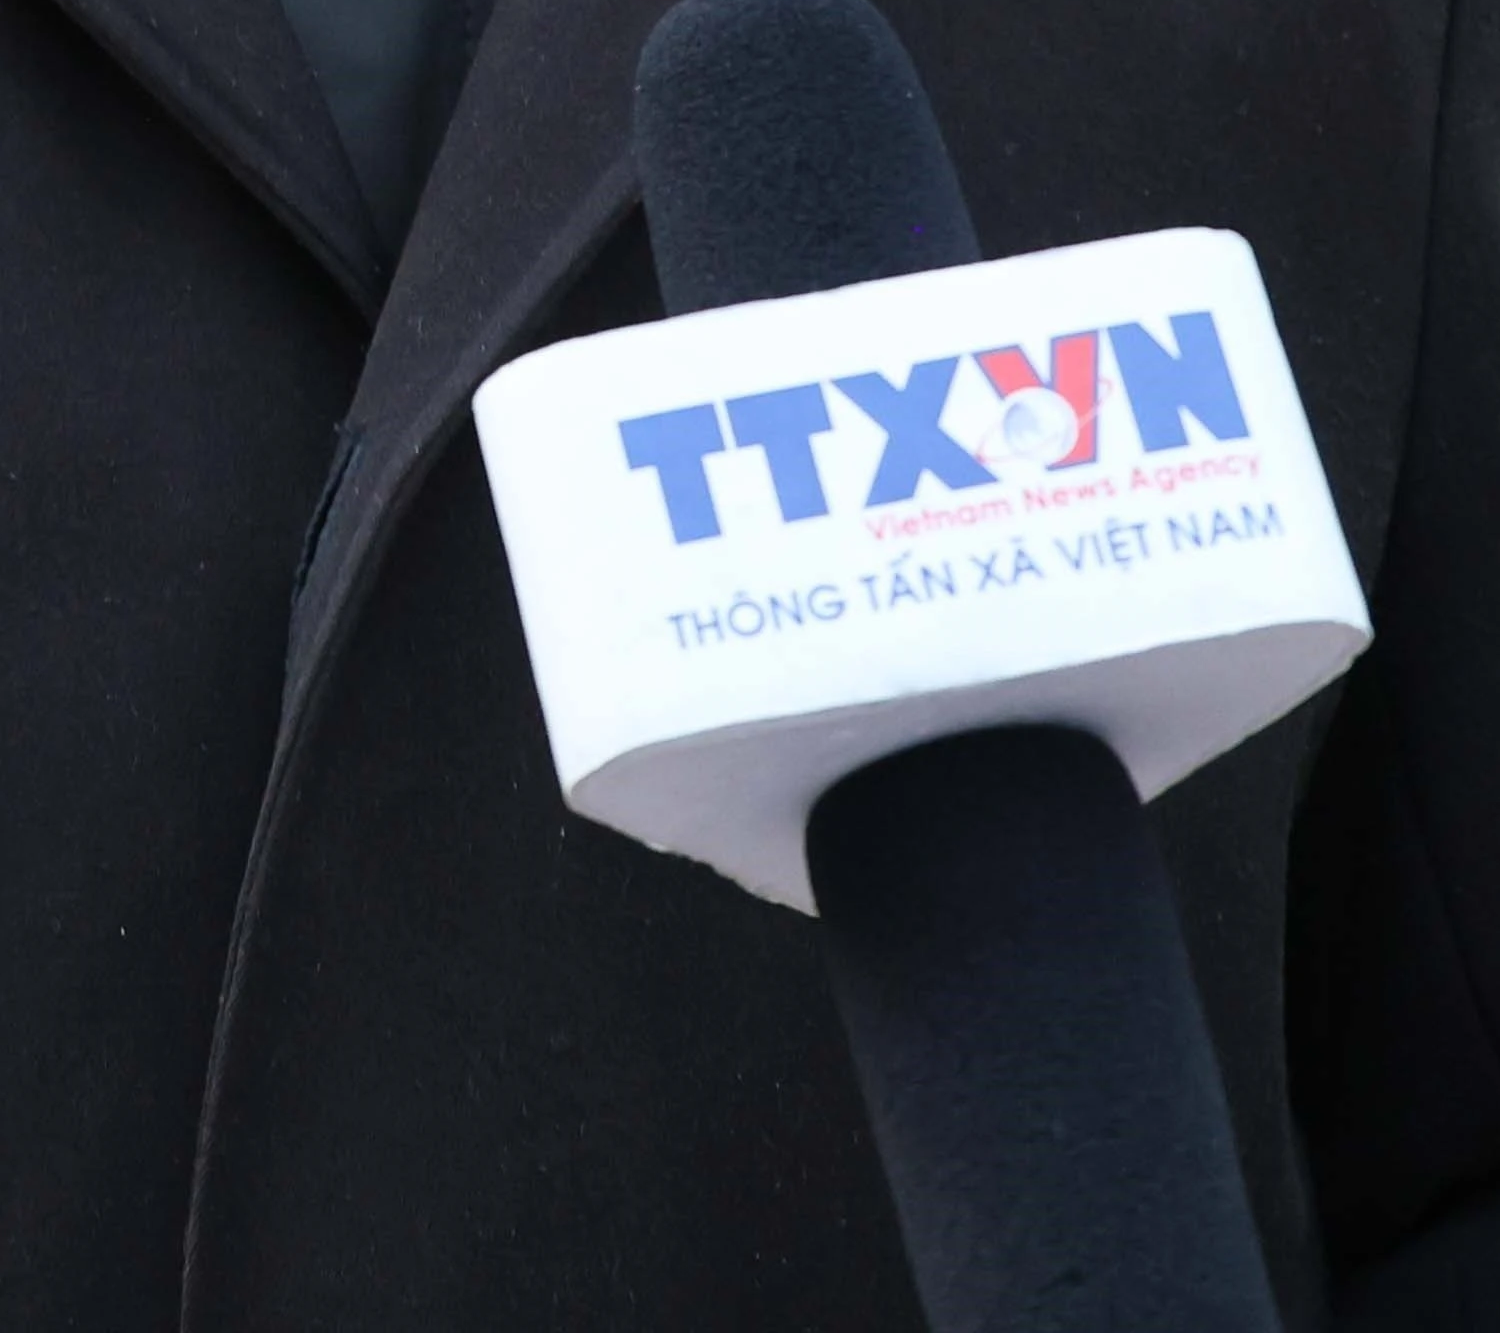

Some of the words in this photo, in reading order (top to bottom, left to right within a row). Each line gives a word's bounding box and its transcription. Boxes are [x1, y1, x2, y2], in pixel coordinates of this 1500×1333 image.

[617, 310, 1251, 546] TTXVN
[864, 497, 1013, 541] Vietnam
[1023, 477, 1117, 512] News
[1130, 453, 1261, 493] Agency
[665, 584, 847, 650] THÔNG
[858, 550, 957, 614] TẤN
[970, 534, 1044, 594] XÃ
[1054, 519, 1151, 573] VIỆT
[1166, 502, 1285, 552] NAM
